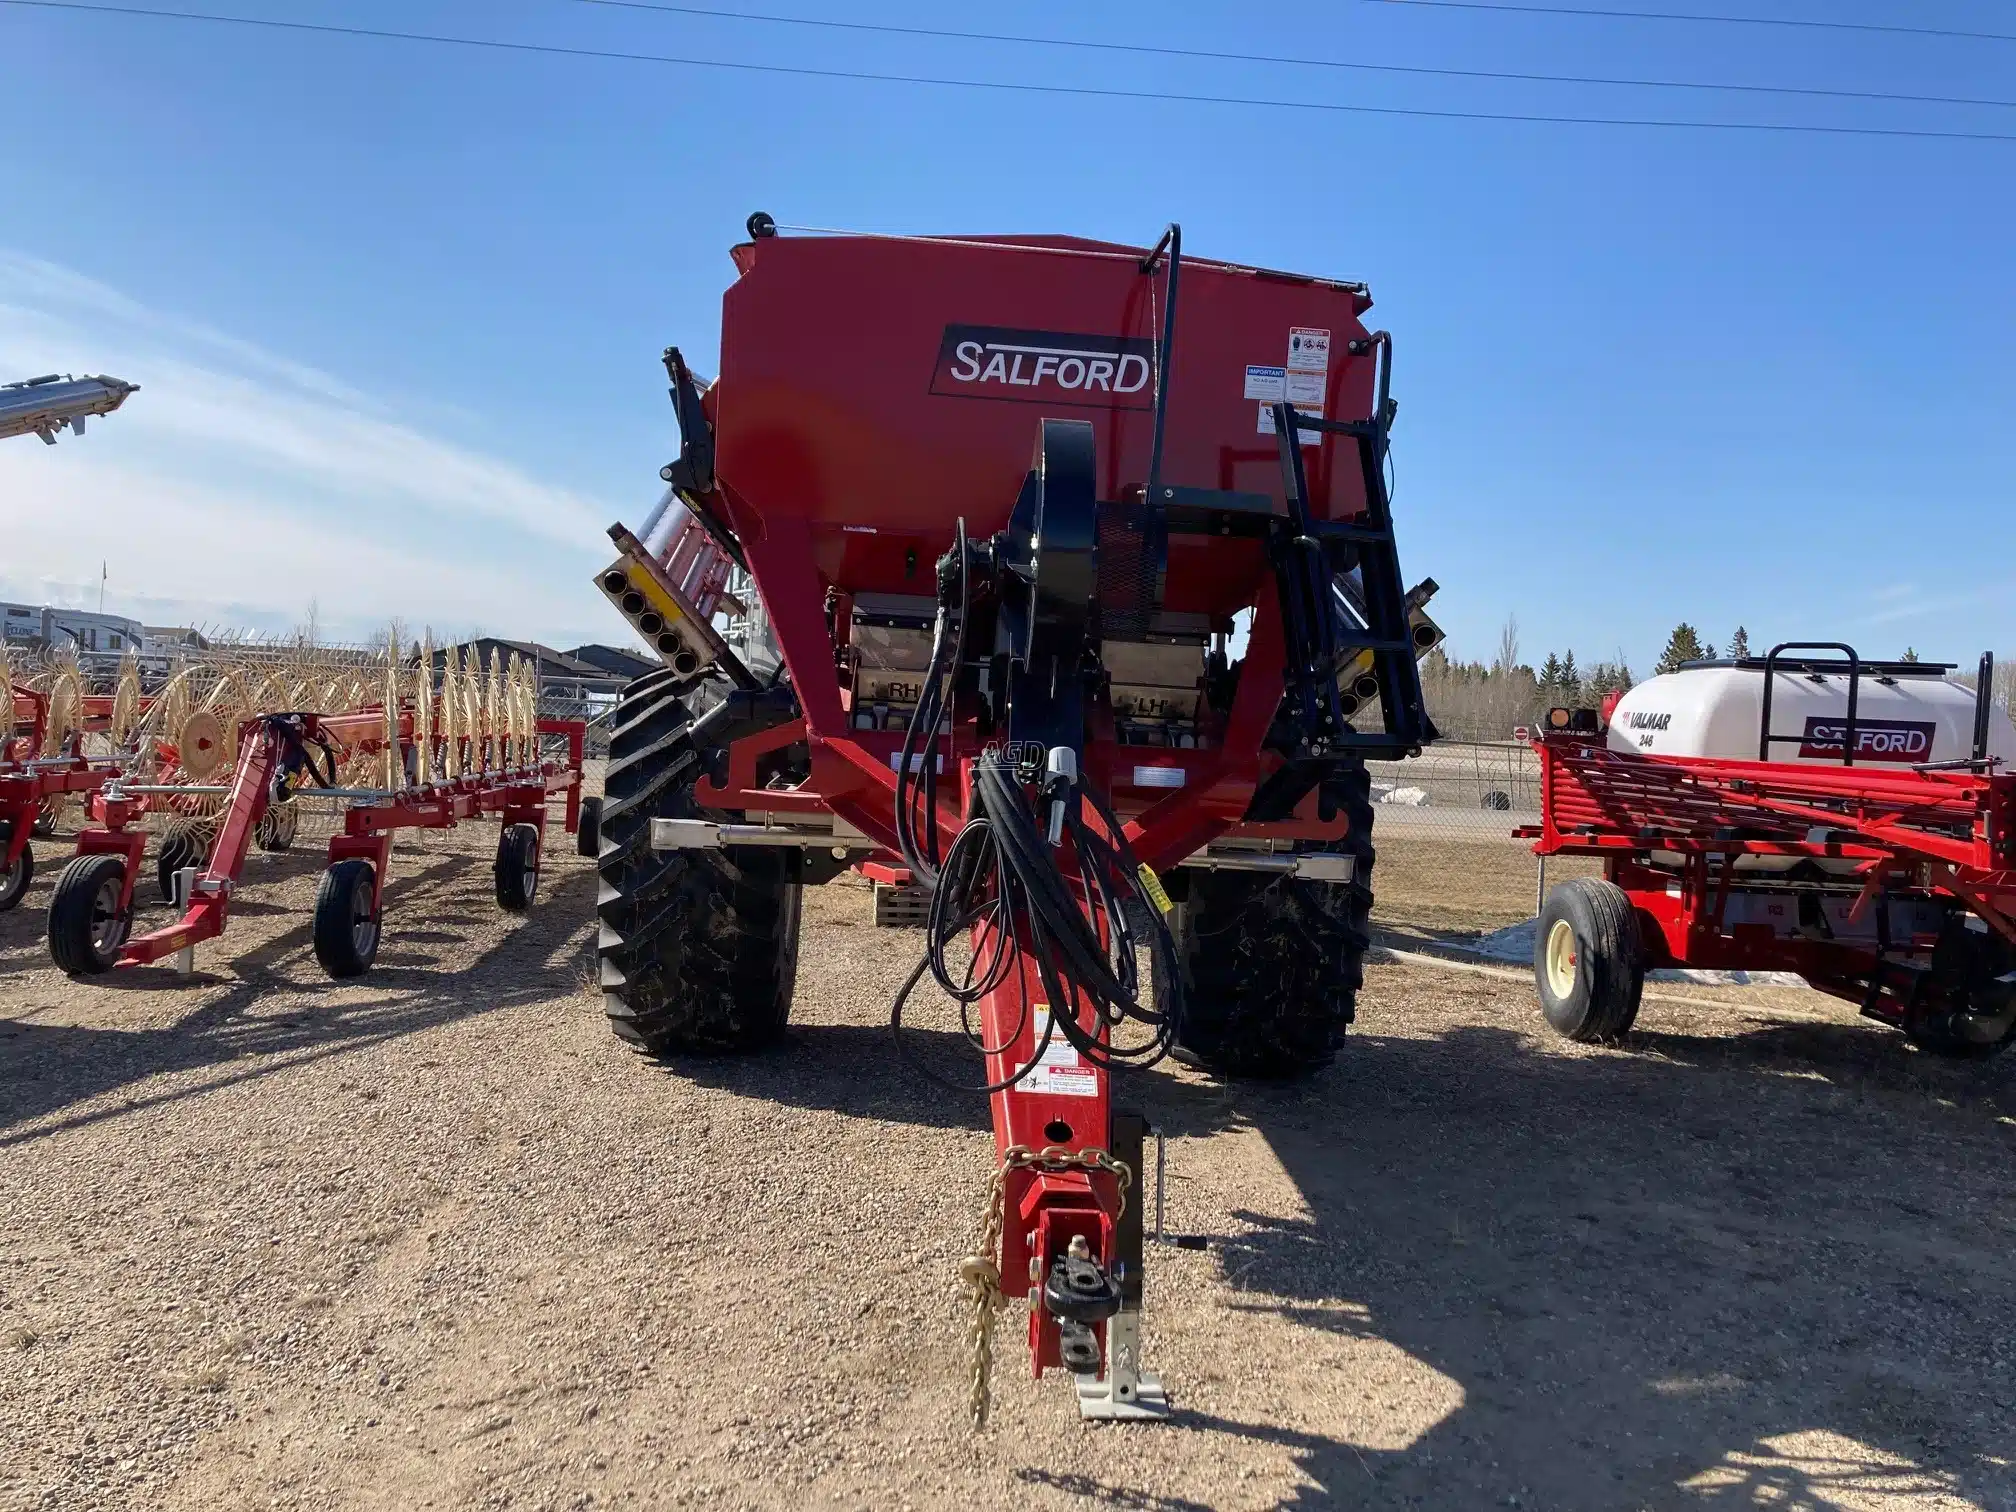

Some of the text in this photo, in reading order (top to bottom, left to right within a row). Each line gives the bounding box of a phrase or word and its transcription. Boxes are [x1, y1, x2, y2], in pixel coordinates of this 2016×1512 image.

[950, 341, 1150, 393] SALFORD
[1248, 367, 1284, 377] IMPORTANT
[889, 682, 920, 698] RH
[1138, 698, 1165, 714] LH
[1630, 712, 1671, 731] VALMAR
[1810, 725, 1927, 753] SAFORD
